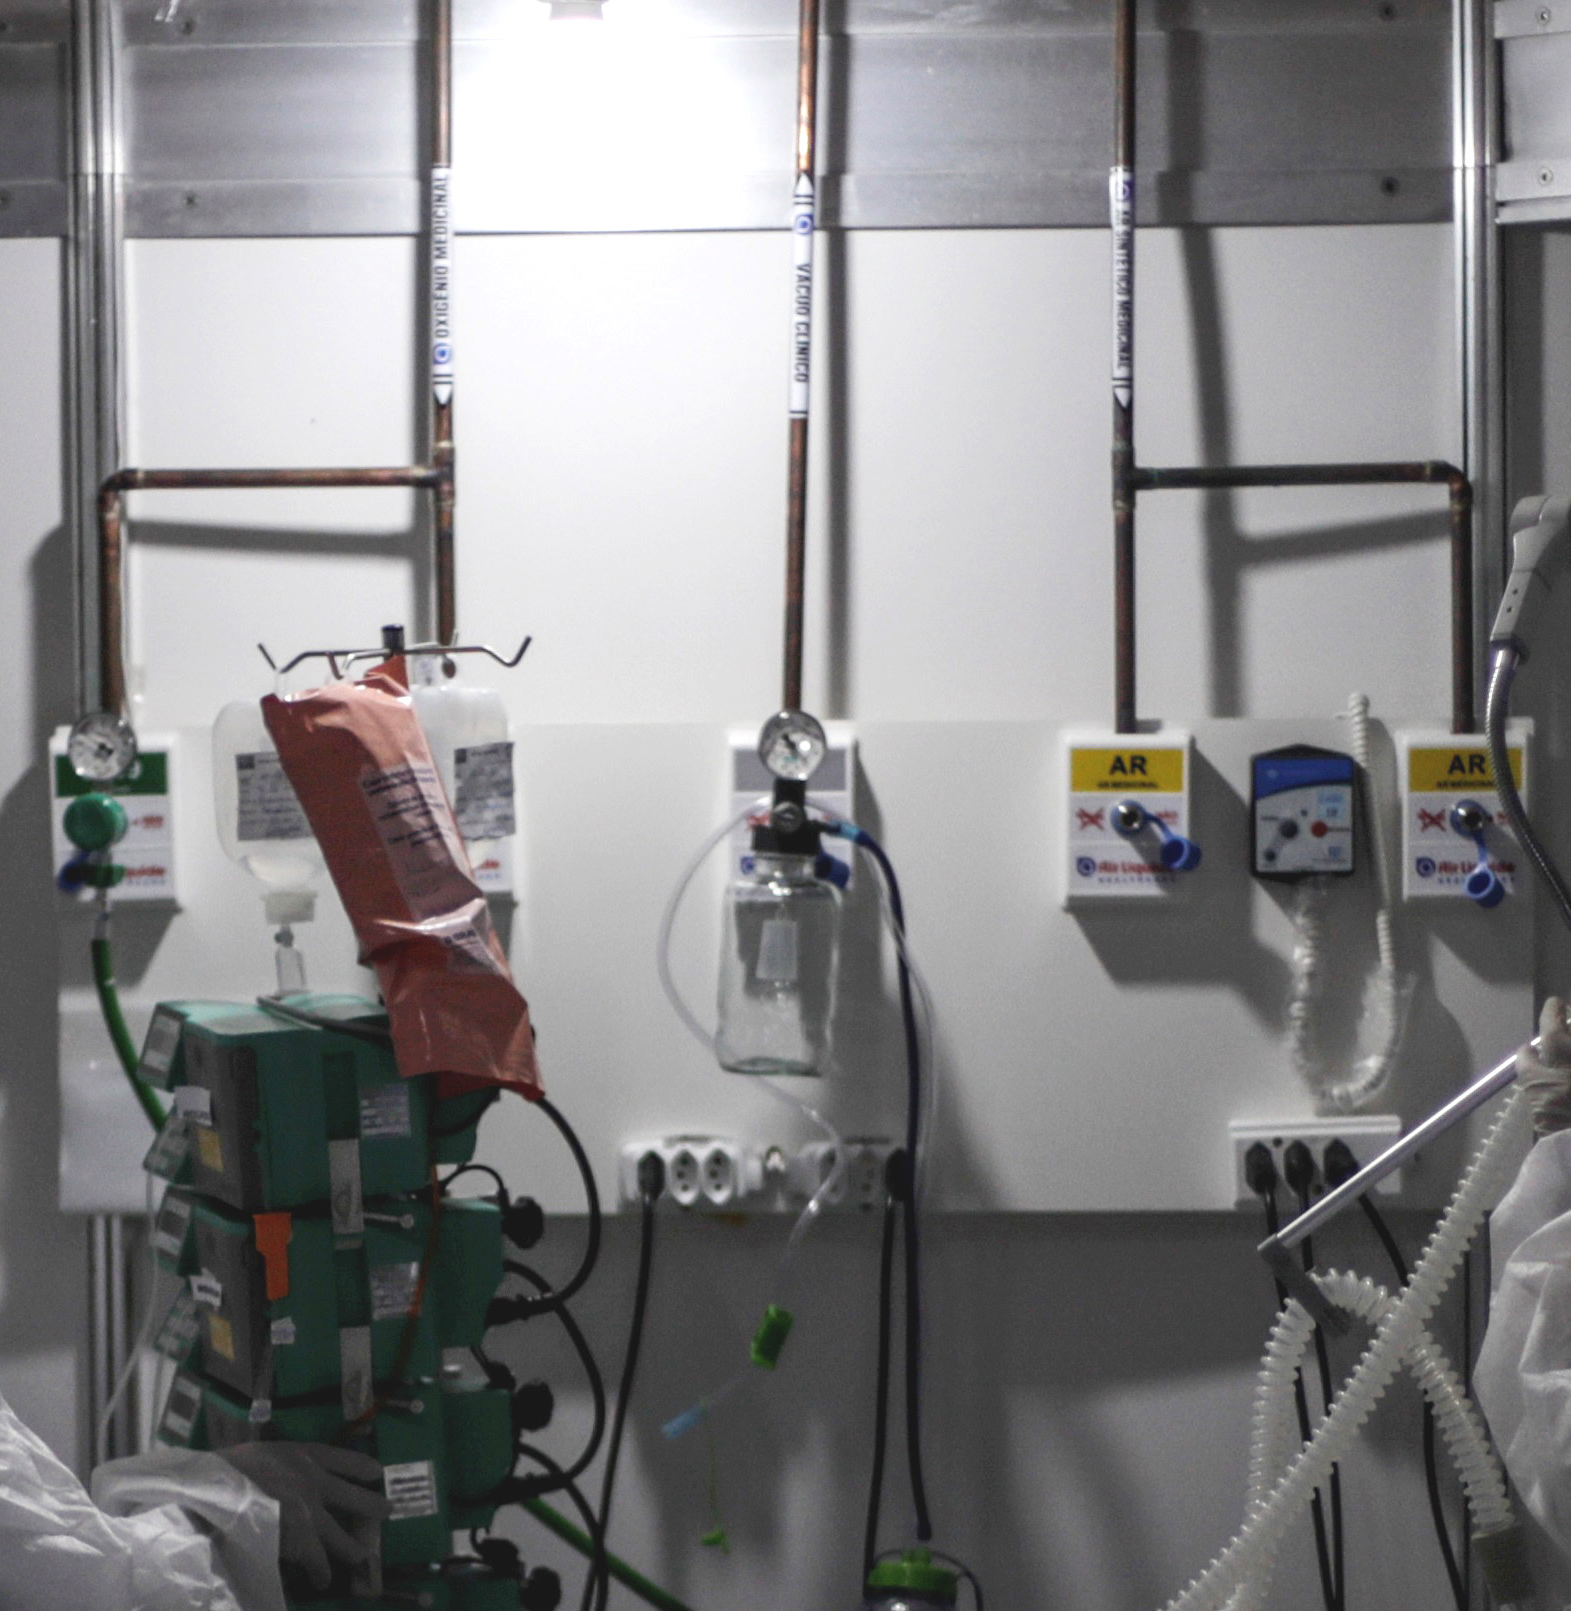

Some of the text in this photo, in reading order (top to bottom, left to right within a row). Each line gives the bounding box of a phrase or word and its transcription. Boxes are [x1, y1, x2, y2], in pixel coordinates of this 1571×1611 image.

[433, 175, 449, 260] MEDICINAL
[1110, 755, 1147, 775] AR
[1448, 754, 1486, 775] AR
